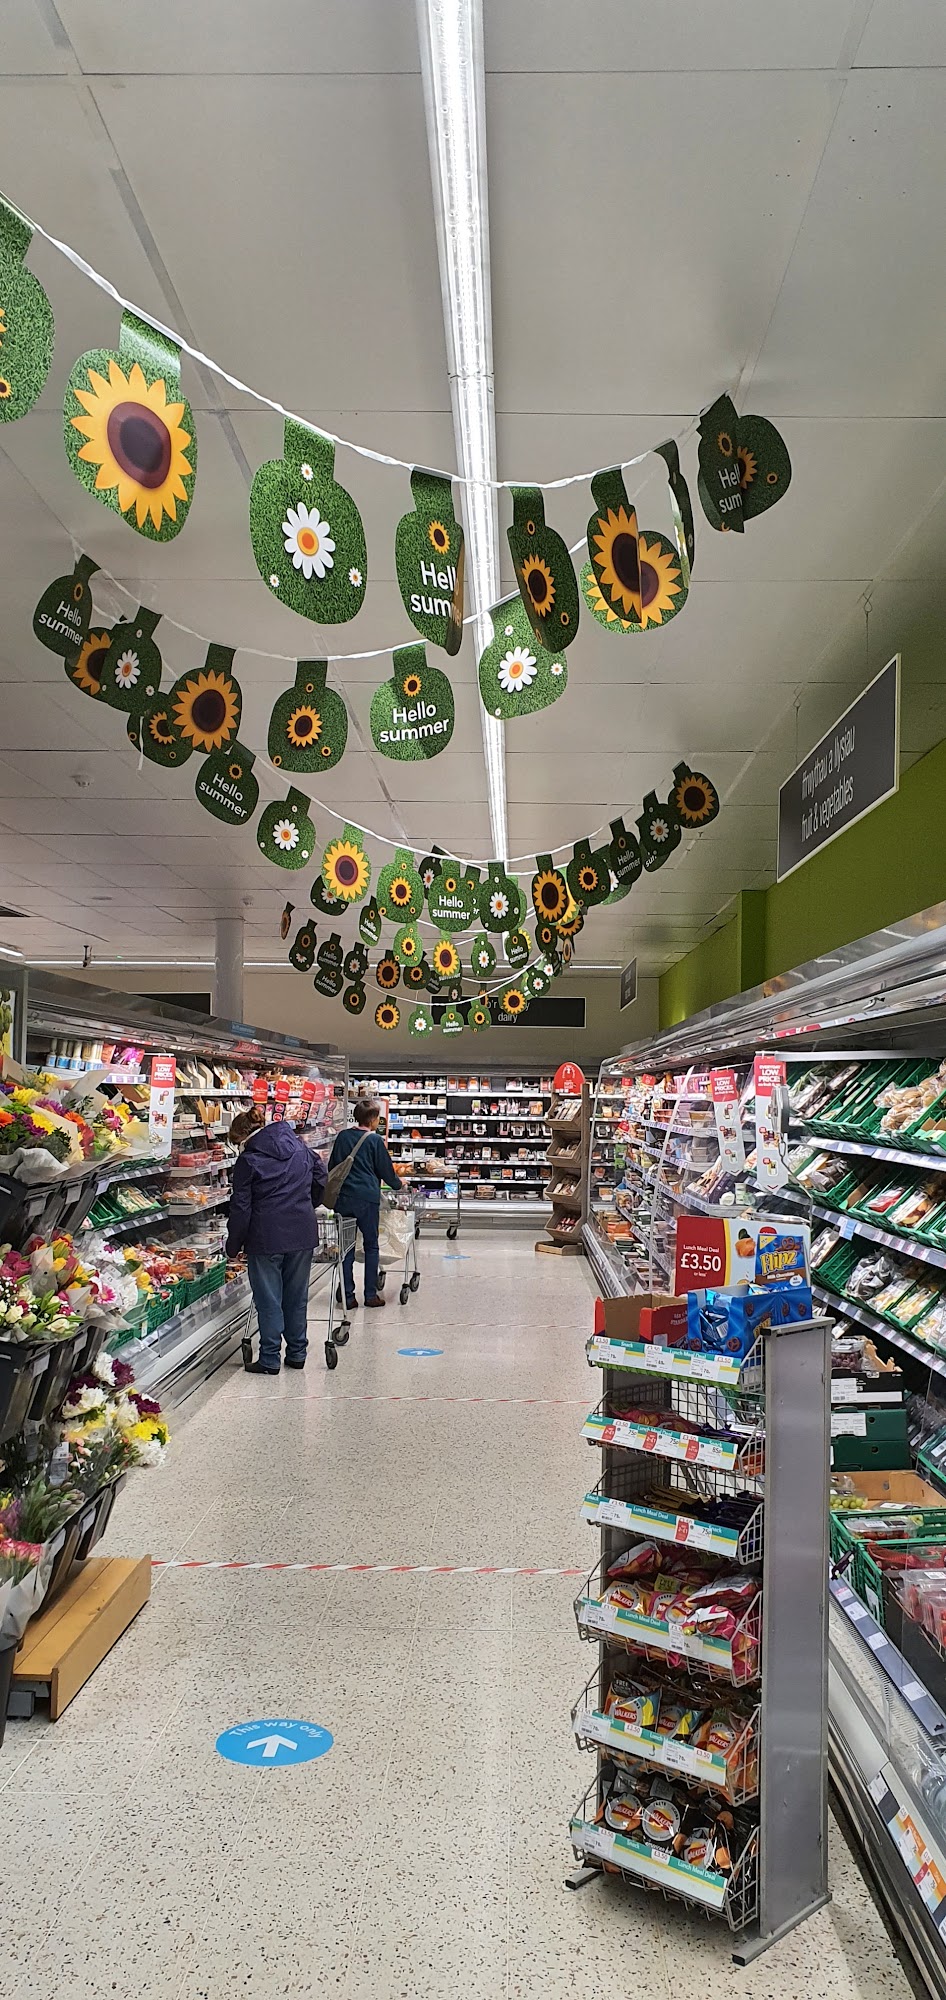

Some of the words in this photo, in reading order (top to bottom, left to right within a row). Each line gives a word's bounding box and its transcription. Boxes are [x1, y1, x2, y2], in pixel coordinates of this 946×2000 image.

[718, 463, 741, 489] Hell
[719, 493, 743, 514] sum
[56, 600, 82, 627] Hello
[38, 613, 83, 646] summer
[392, 701, 437, 724] Hello
[380, 719, 450, 743] summer
[212, 773, 244, 802] Hello
[199, 782, 248, 818] summer
[802, 808, 813, 842] fruit
[813, 802, 819, 832] &
[819, 775, 854, 828] vegetables
[617, 850, 635, 866] Hello
[616, 857, 641, 878] summer
[438, 895, 464, 908] Hello
[432, 908, 470, 920] summer
[363, 918, 377, 932] Hello
[359, 924, 379, 942] summer
[509, 951, 528, 964] summer
[510, 945, 524, 956] Hello
[315, 980, 338, 994] summer
[322, 976, 336, 988] Hello
[498, 1012, 518, 1023] dairy
[680, 1252, 721, 1272] £3.50
[761, 1250, 797, 1275] Flipz
[669, 1349, 684, 1357] Lunch
[637, 1426, 652, 1434] Lunch
[633, 1506, 647, 1514] Lunch
[646, 1509, 658, 1517] Meal
[657, 1511, 668, 1519] Deal
[625, 1611, 639, 1619] Lunch
[638, 1614, 650, 1622] Meal
[650, 1617, 661, 1625] Deal
[614, 1709, 637, 1721] WALKERS
[229, 1724, 261, 1736] This
[264, 1721, 298, 1729] way
[299, 1725, 324, 1738] only
[626, 1724, 641, 1733] £3.50
[649, 1732, 663, 1741] Lunch
[696, 1750, 711, 1759] £3.50
[600, 1830, 614, 1838] £3.50
[626, 1840, 640, 1849] Snack
[654, 1850, 668, 1860] £3.50
[677, 1860, 692, 1870] Lunch
[692, 1866, 704, 1875] Meal
[704, 1871, 717, 1880] Deal
